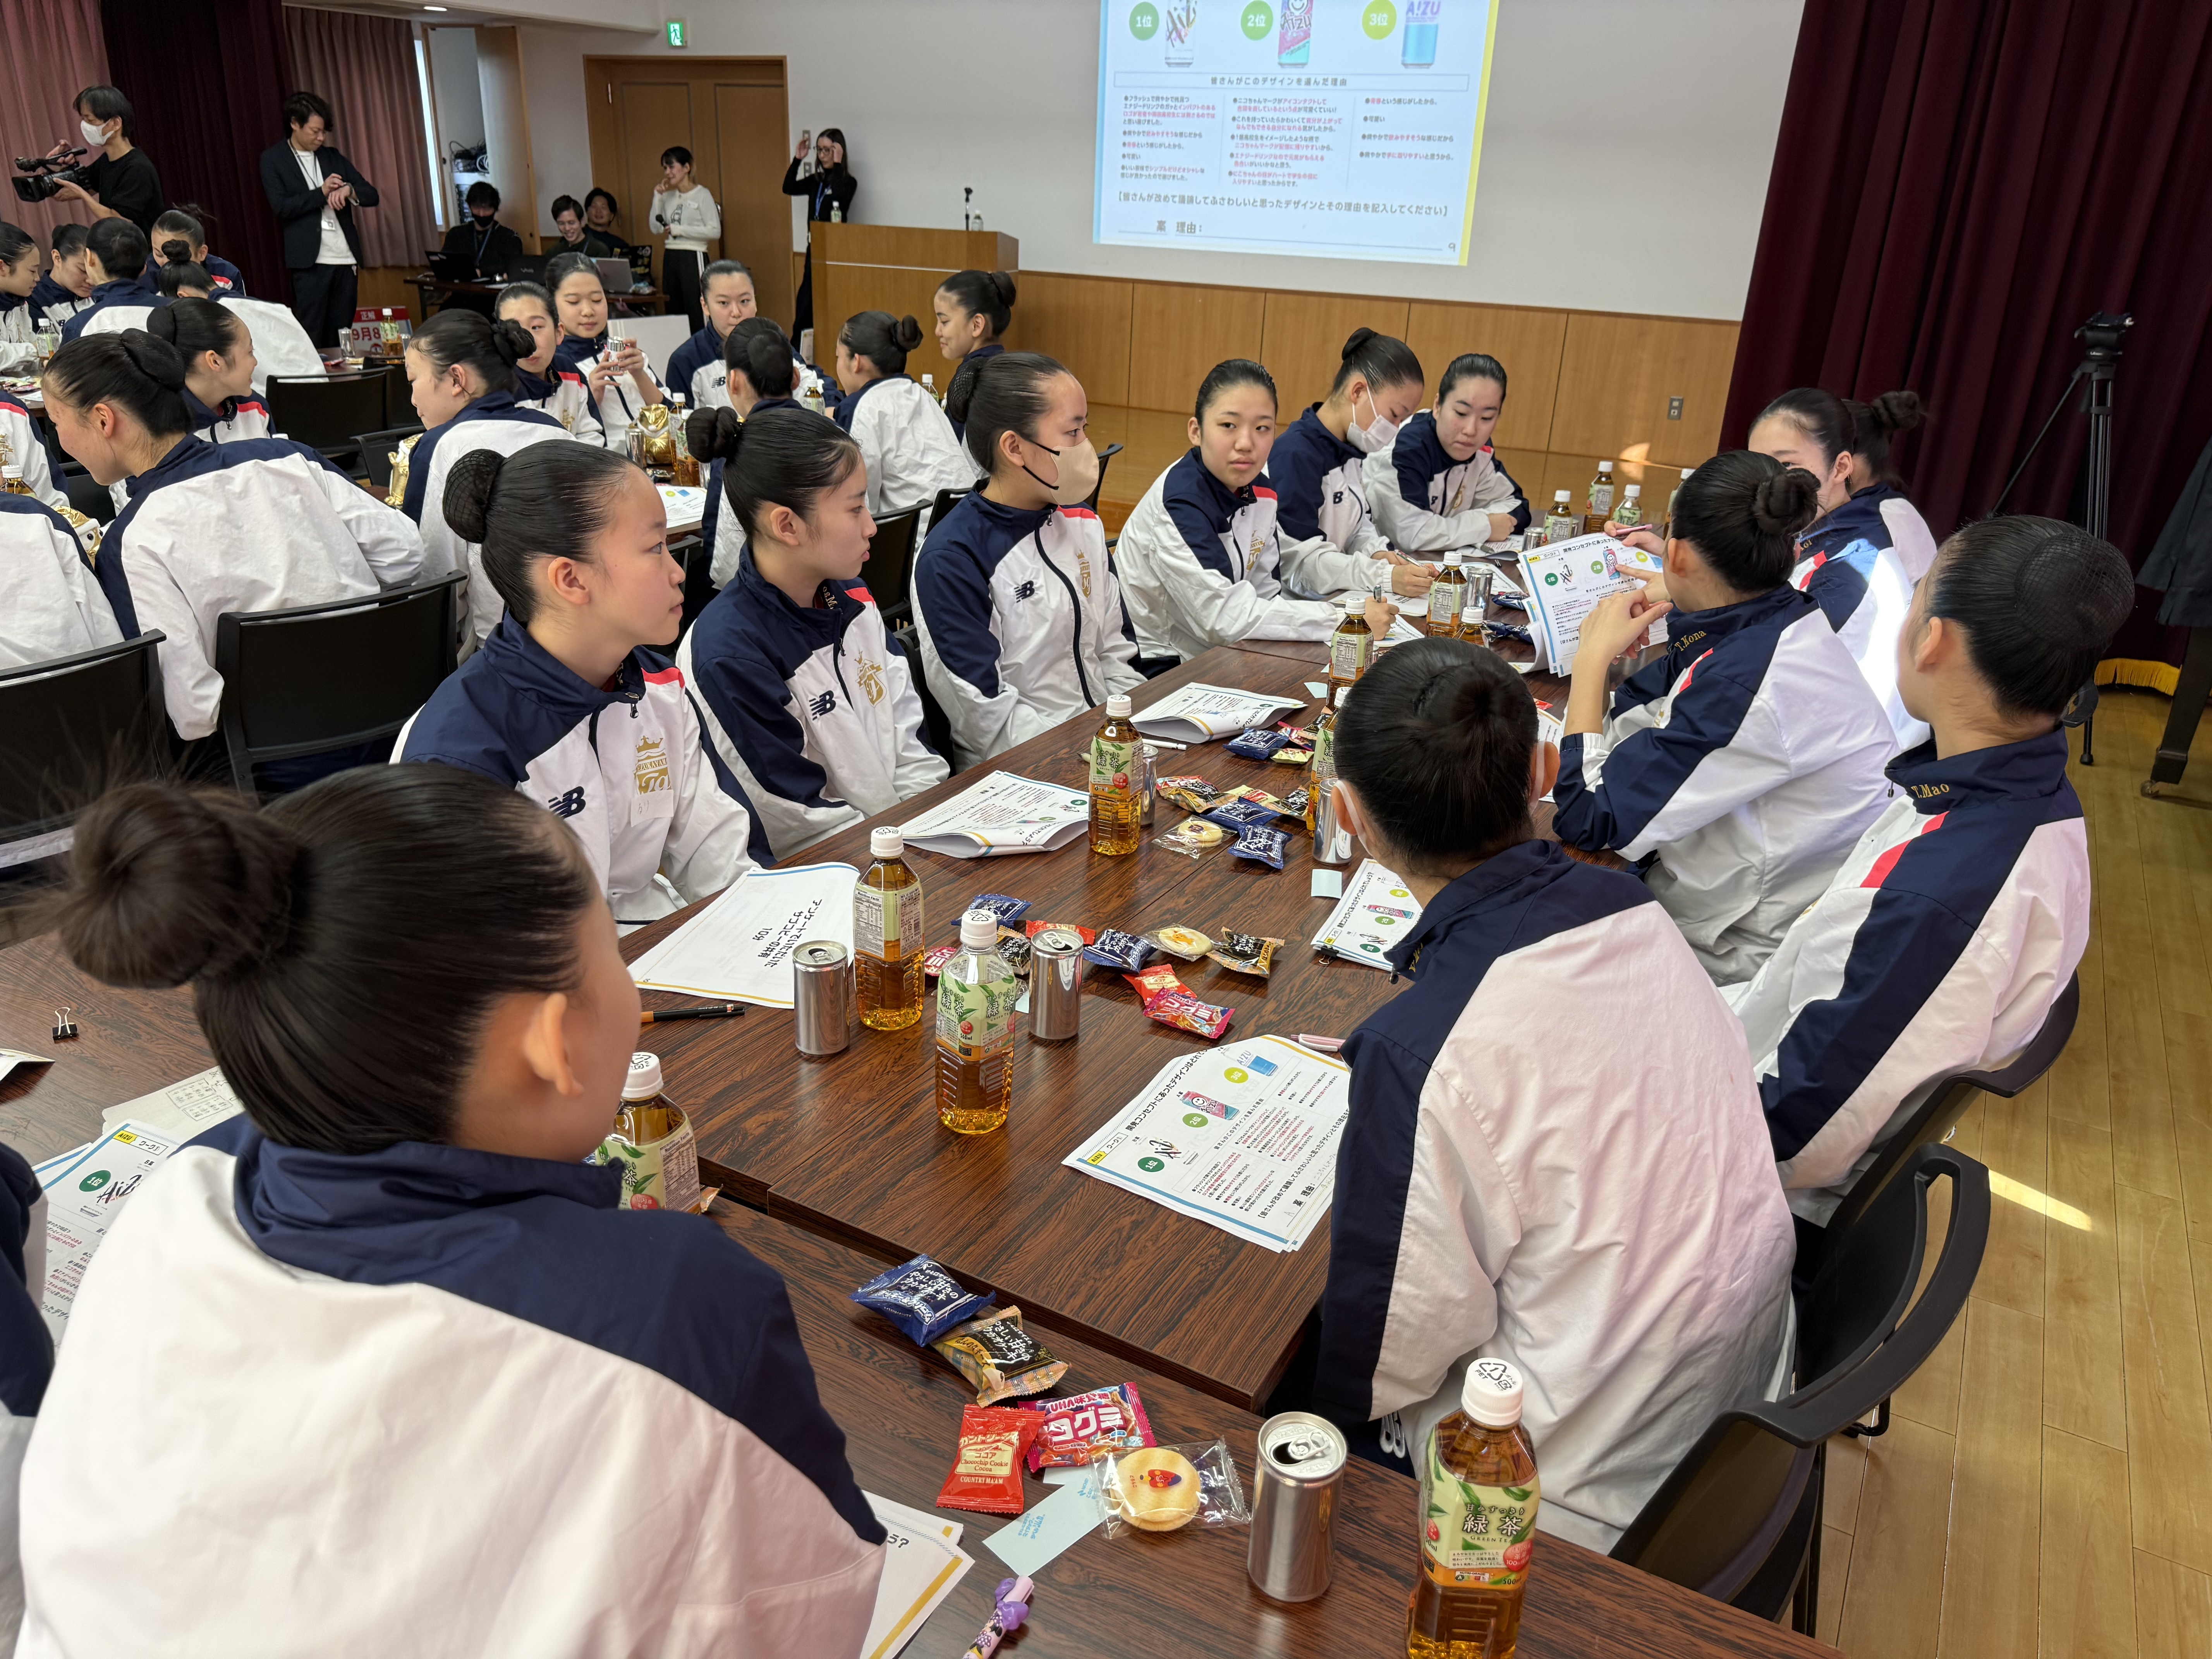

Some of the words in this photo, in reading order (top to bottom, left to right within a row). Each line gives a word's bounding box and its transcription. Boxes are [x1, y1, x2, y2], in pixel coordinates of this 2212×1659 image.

[1136, 16, 1152, 27] 1位
[1247, 15, 1266, 27] 2位
[1369, 13, 1388, 26] 3位
[1911, 784, 1949, 799] T.Mao
[764, 899, 822, 967] アンケートでいただいた
[941, 992, 964, 1016] 緑茶
[986, 995, 1014, 1018] 緑茶
[1231, 1071, 1242, 1080] 3位
[1189, 1116, 1202, 1125] 2位
[1145, 1160, 1158, 1170] 1位
[623, 1169, 639, 1187] 茶
[909, 1271, 959, 1299] やさしい甘さの
[1475, 1369, 1488, 1379] PET
[1046, 1405, 1124, 1443] コグミ
[1467, 1504, 1525, 1515] 甘みすっきり
[1462, 1513, 1522, 1536] 緑茶
